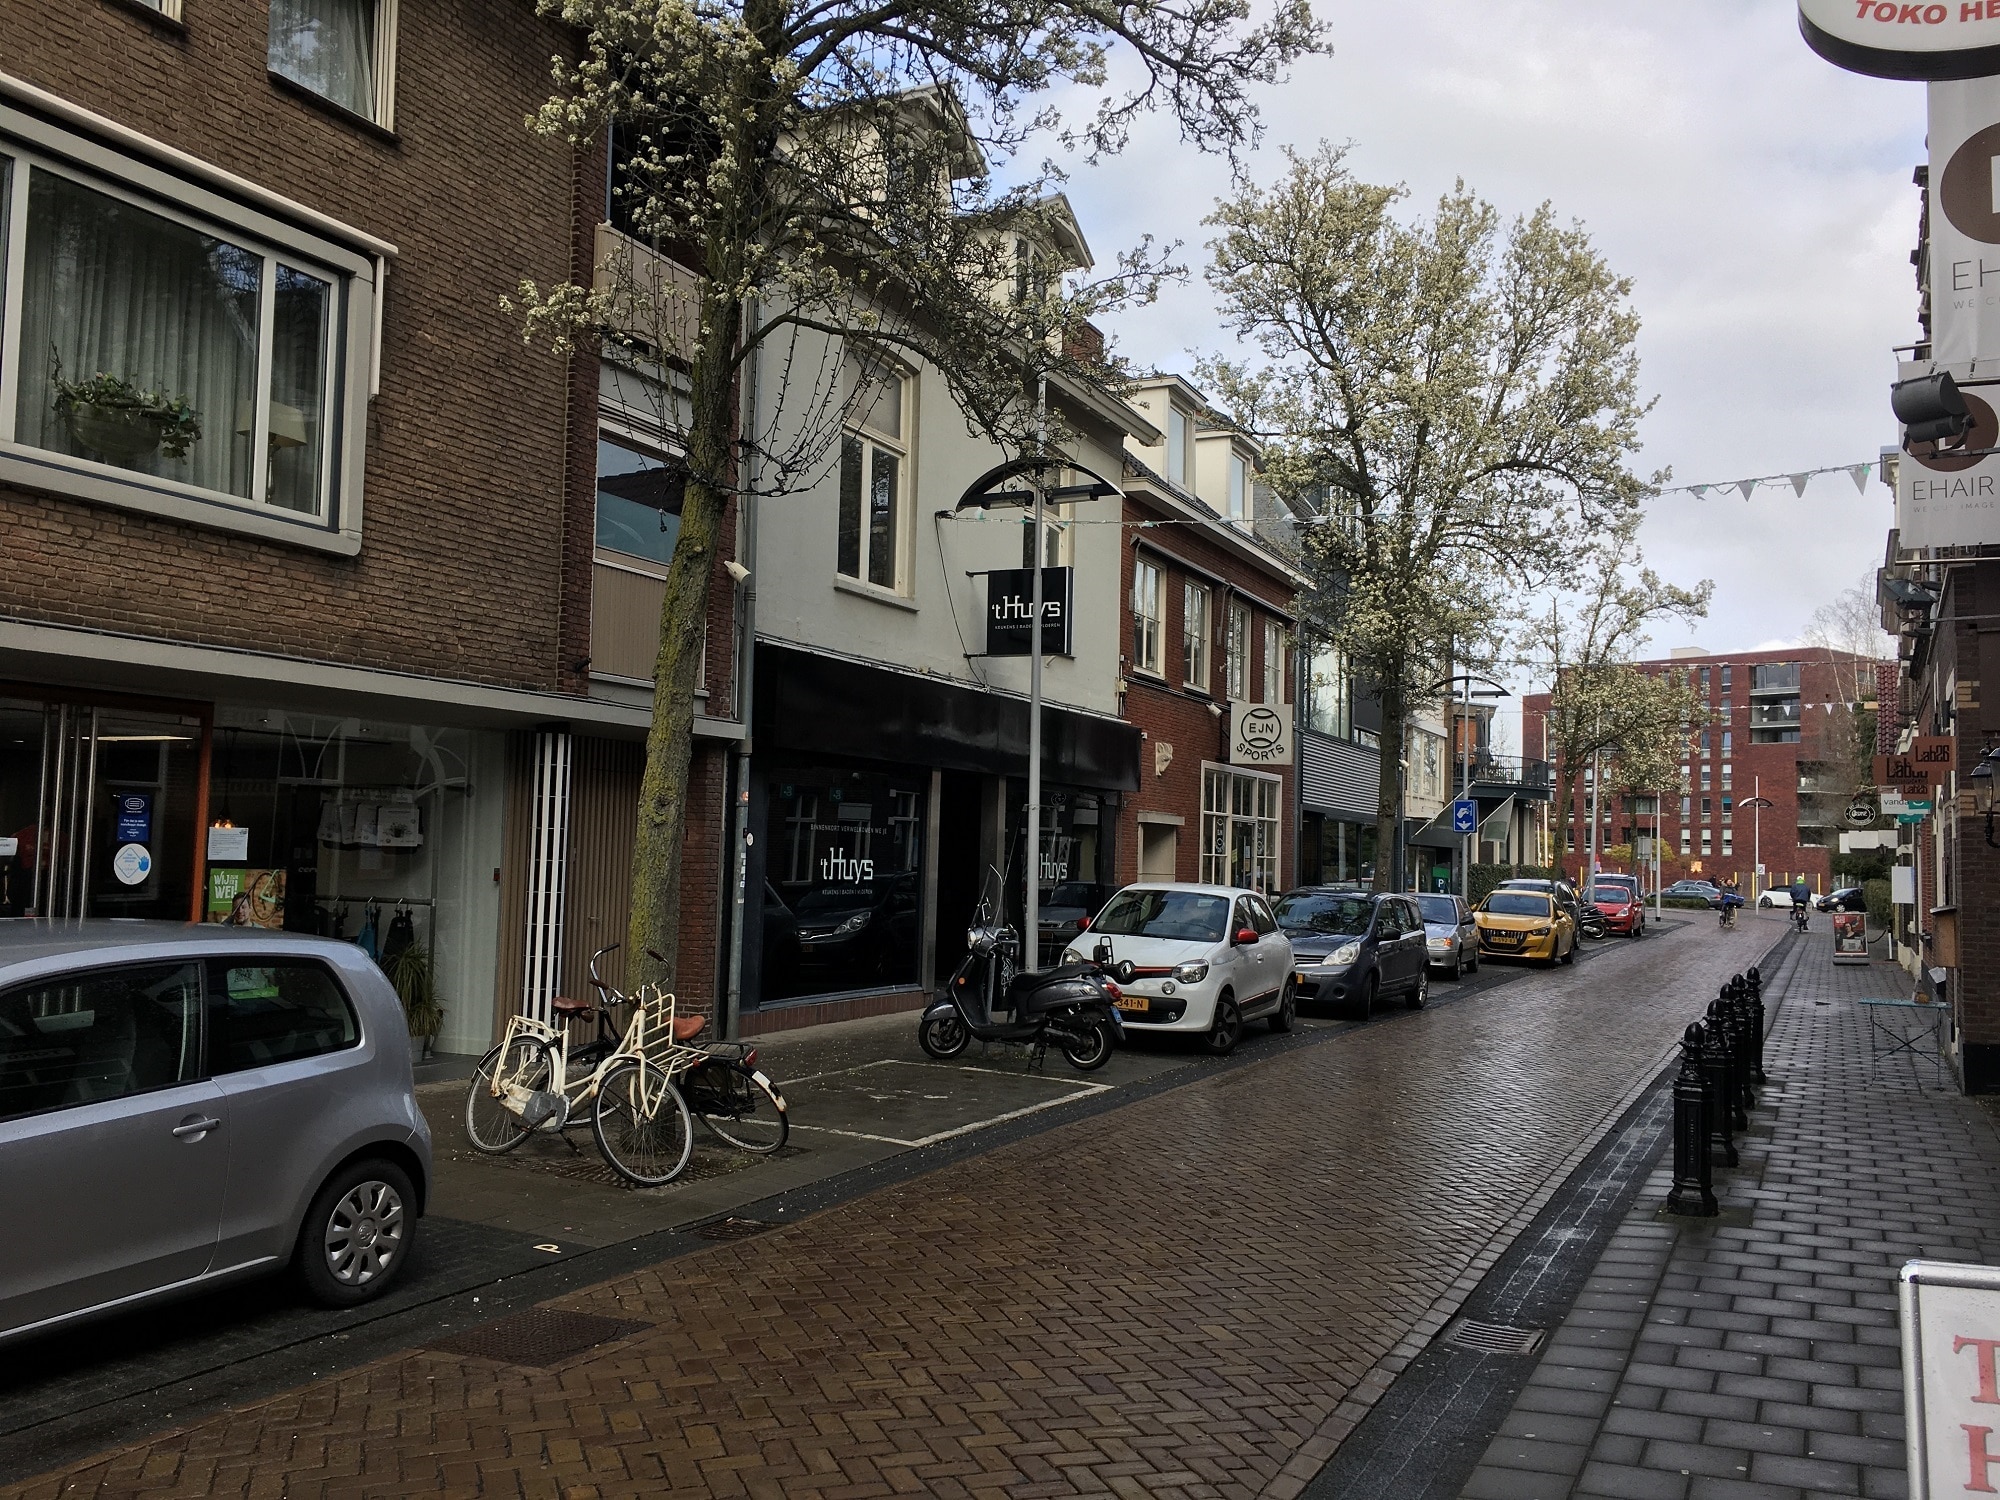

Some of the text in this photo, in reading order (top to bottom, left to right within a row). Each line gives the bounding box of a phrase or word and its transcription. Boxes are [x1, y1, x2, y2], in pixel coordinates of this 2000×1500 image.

[1856, 0, 1947, 24] TOKO
[1953, 299, 1975, 310] WE
[1913, 476, 1994, 500] EHAIR
[1960, 502, 1995, 510] IMAGE
[1249, 722, 1274, 733] EJN
[1236, 742, 1285, 761] SPORTS
[1915, 745, 1950, 762] Lab26
